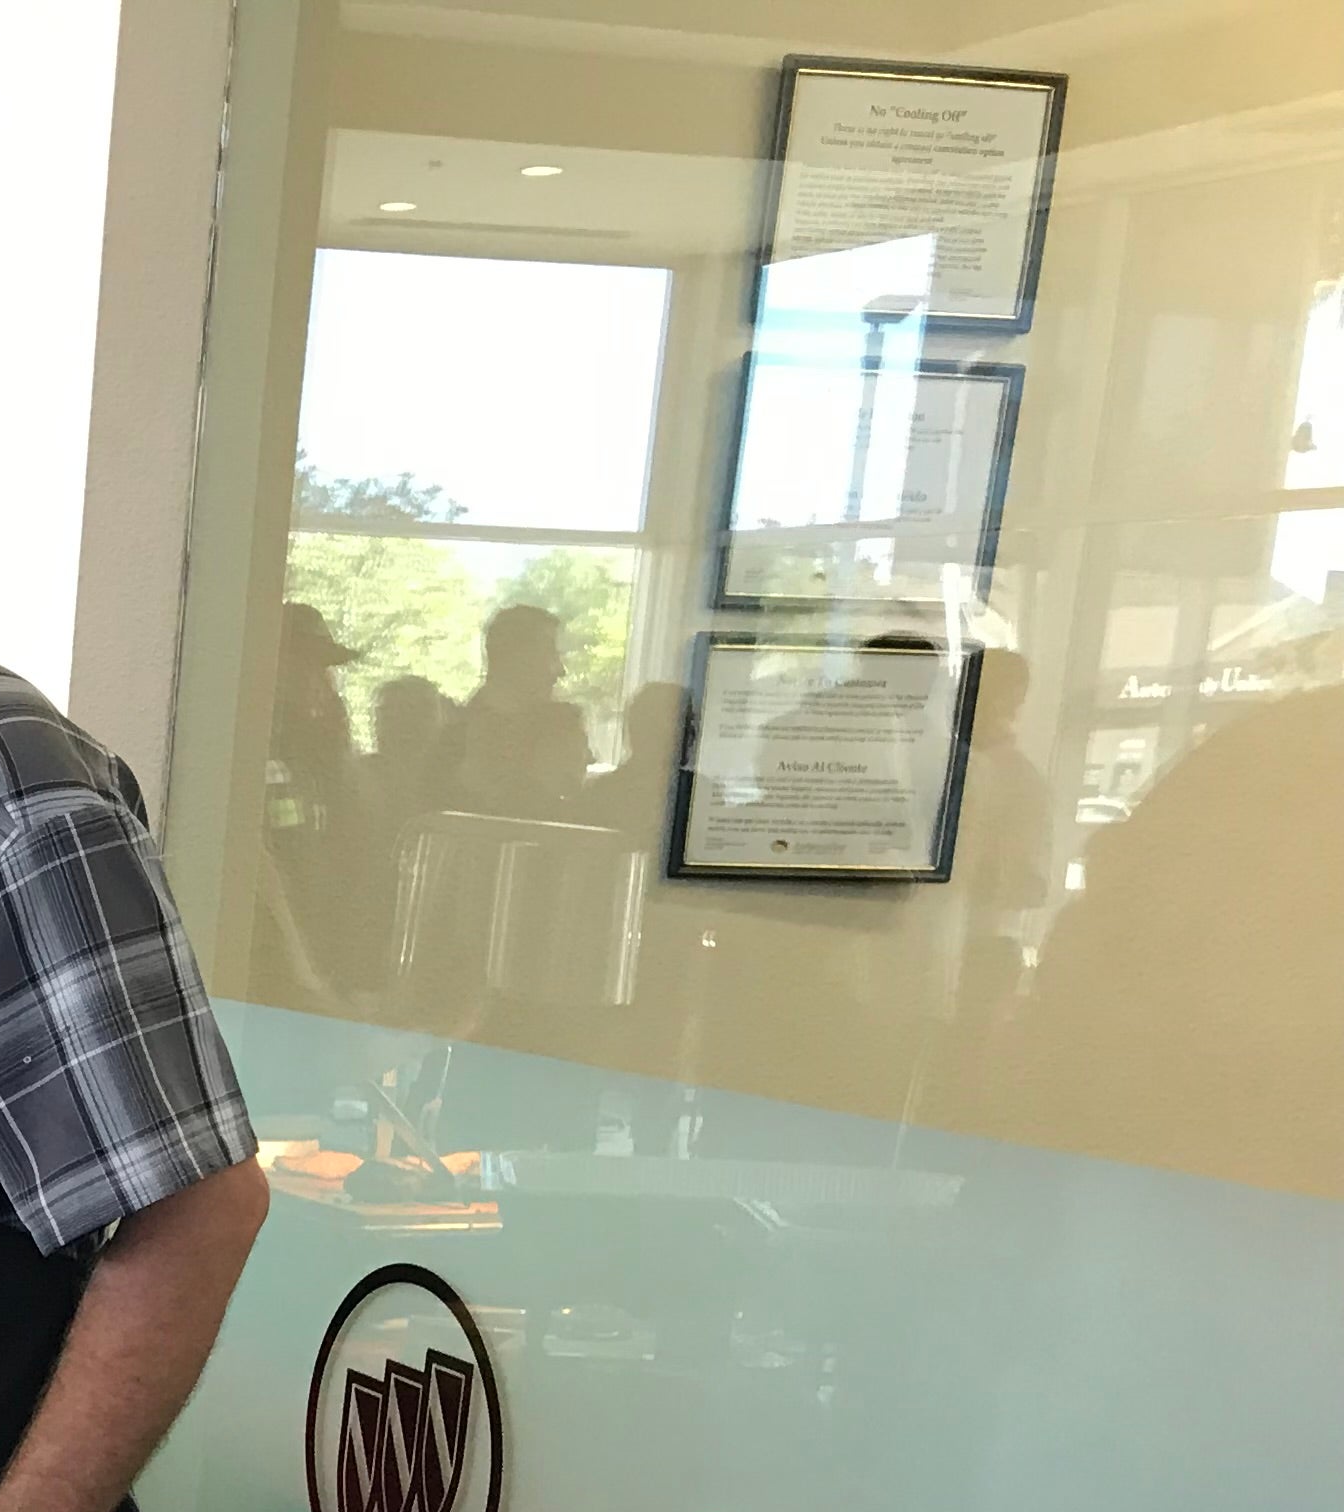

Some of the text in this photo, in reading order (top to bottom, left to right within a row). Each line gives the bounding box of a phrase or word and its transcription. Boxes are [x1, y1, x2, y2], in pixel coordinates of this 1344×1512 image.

[870, 105, 886, 117] No
[890, 106, 939, 123] "Cooling
[778, 760, 868, 774] Aviso Al Cliente
